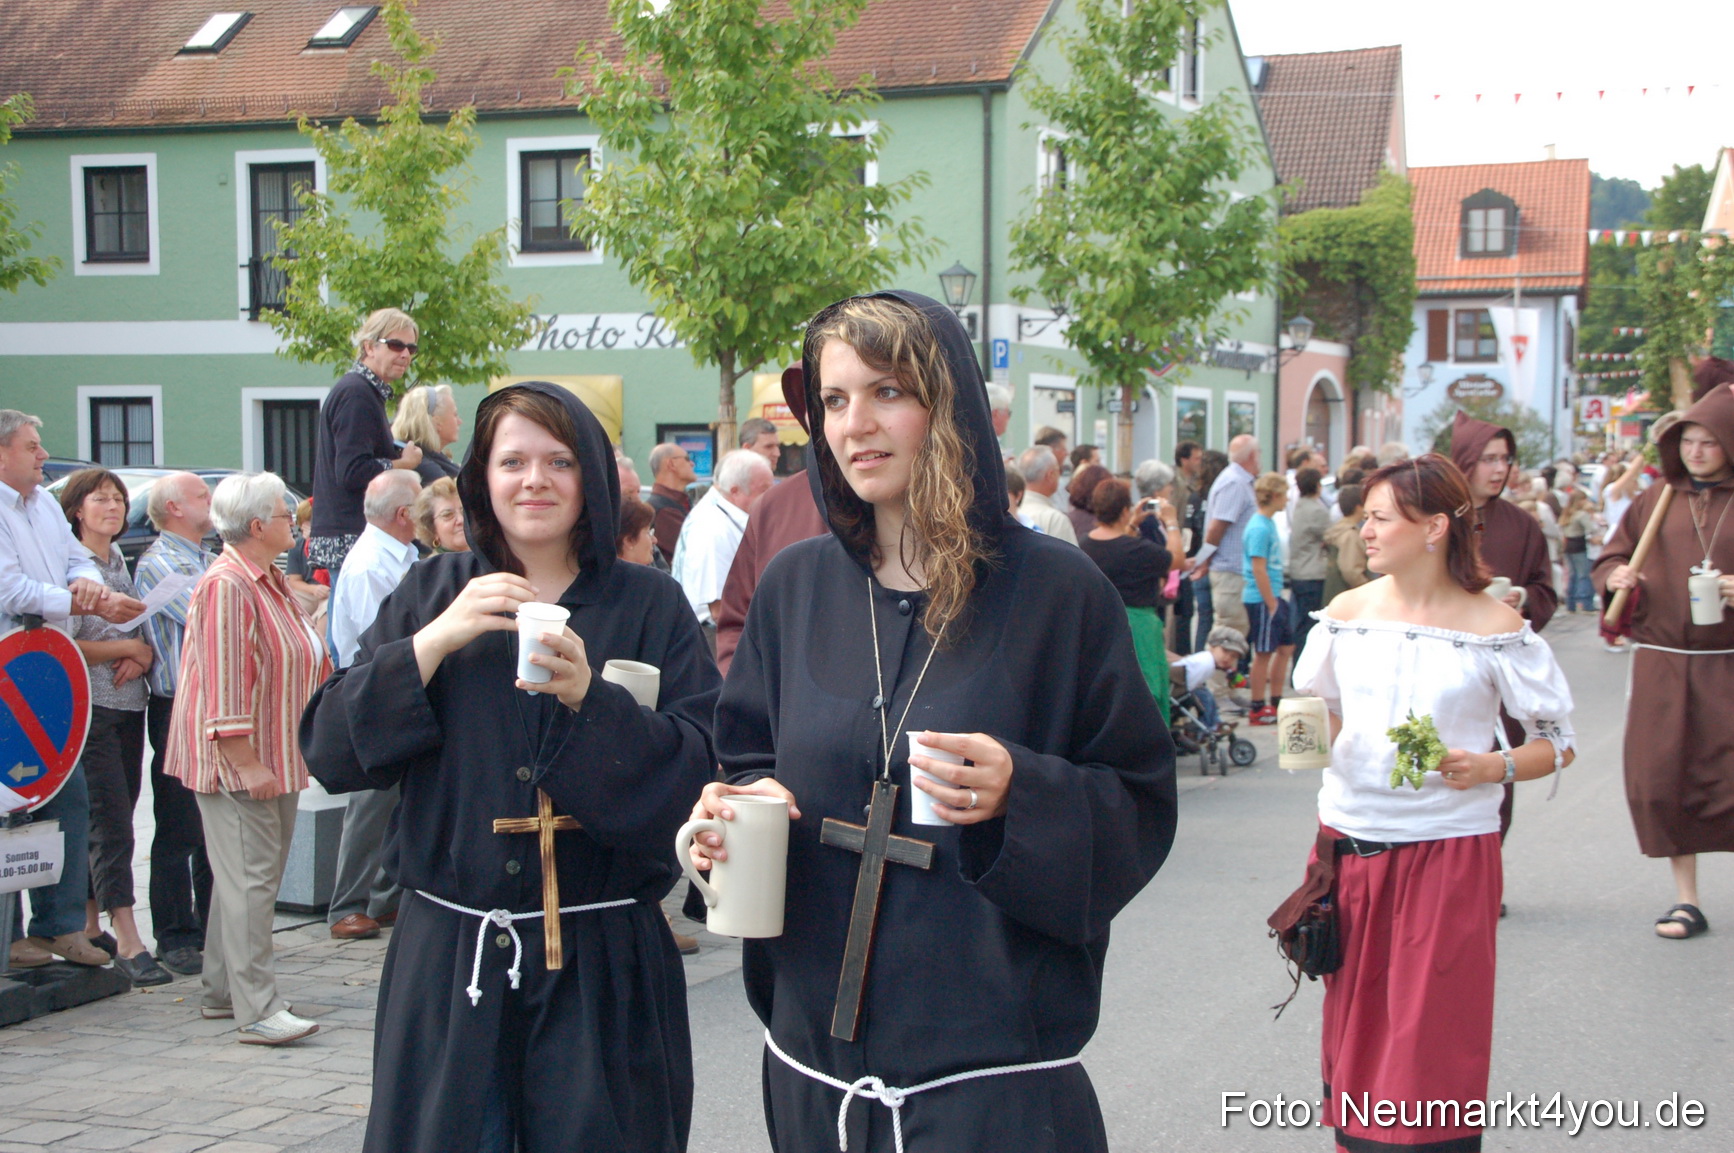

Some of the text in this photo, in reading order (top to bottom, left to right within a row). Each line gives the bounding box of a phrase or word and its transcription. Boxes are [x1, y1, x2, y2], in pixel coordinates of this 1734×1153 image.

[995, 341, 1007, 366] P
[5, 850, 40, 863] Sonntag
[40, 861, 54, 872] Uhr
